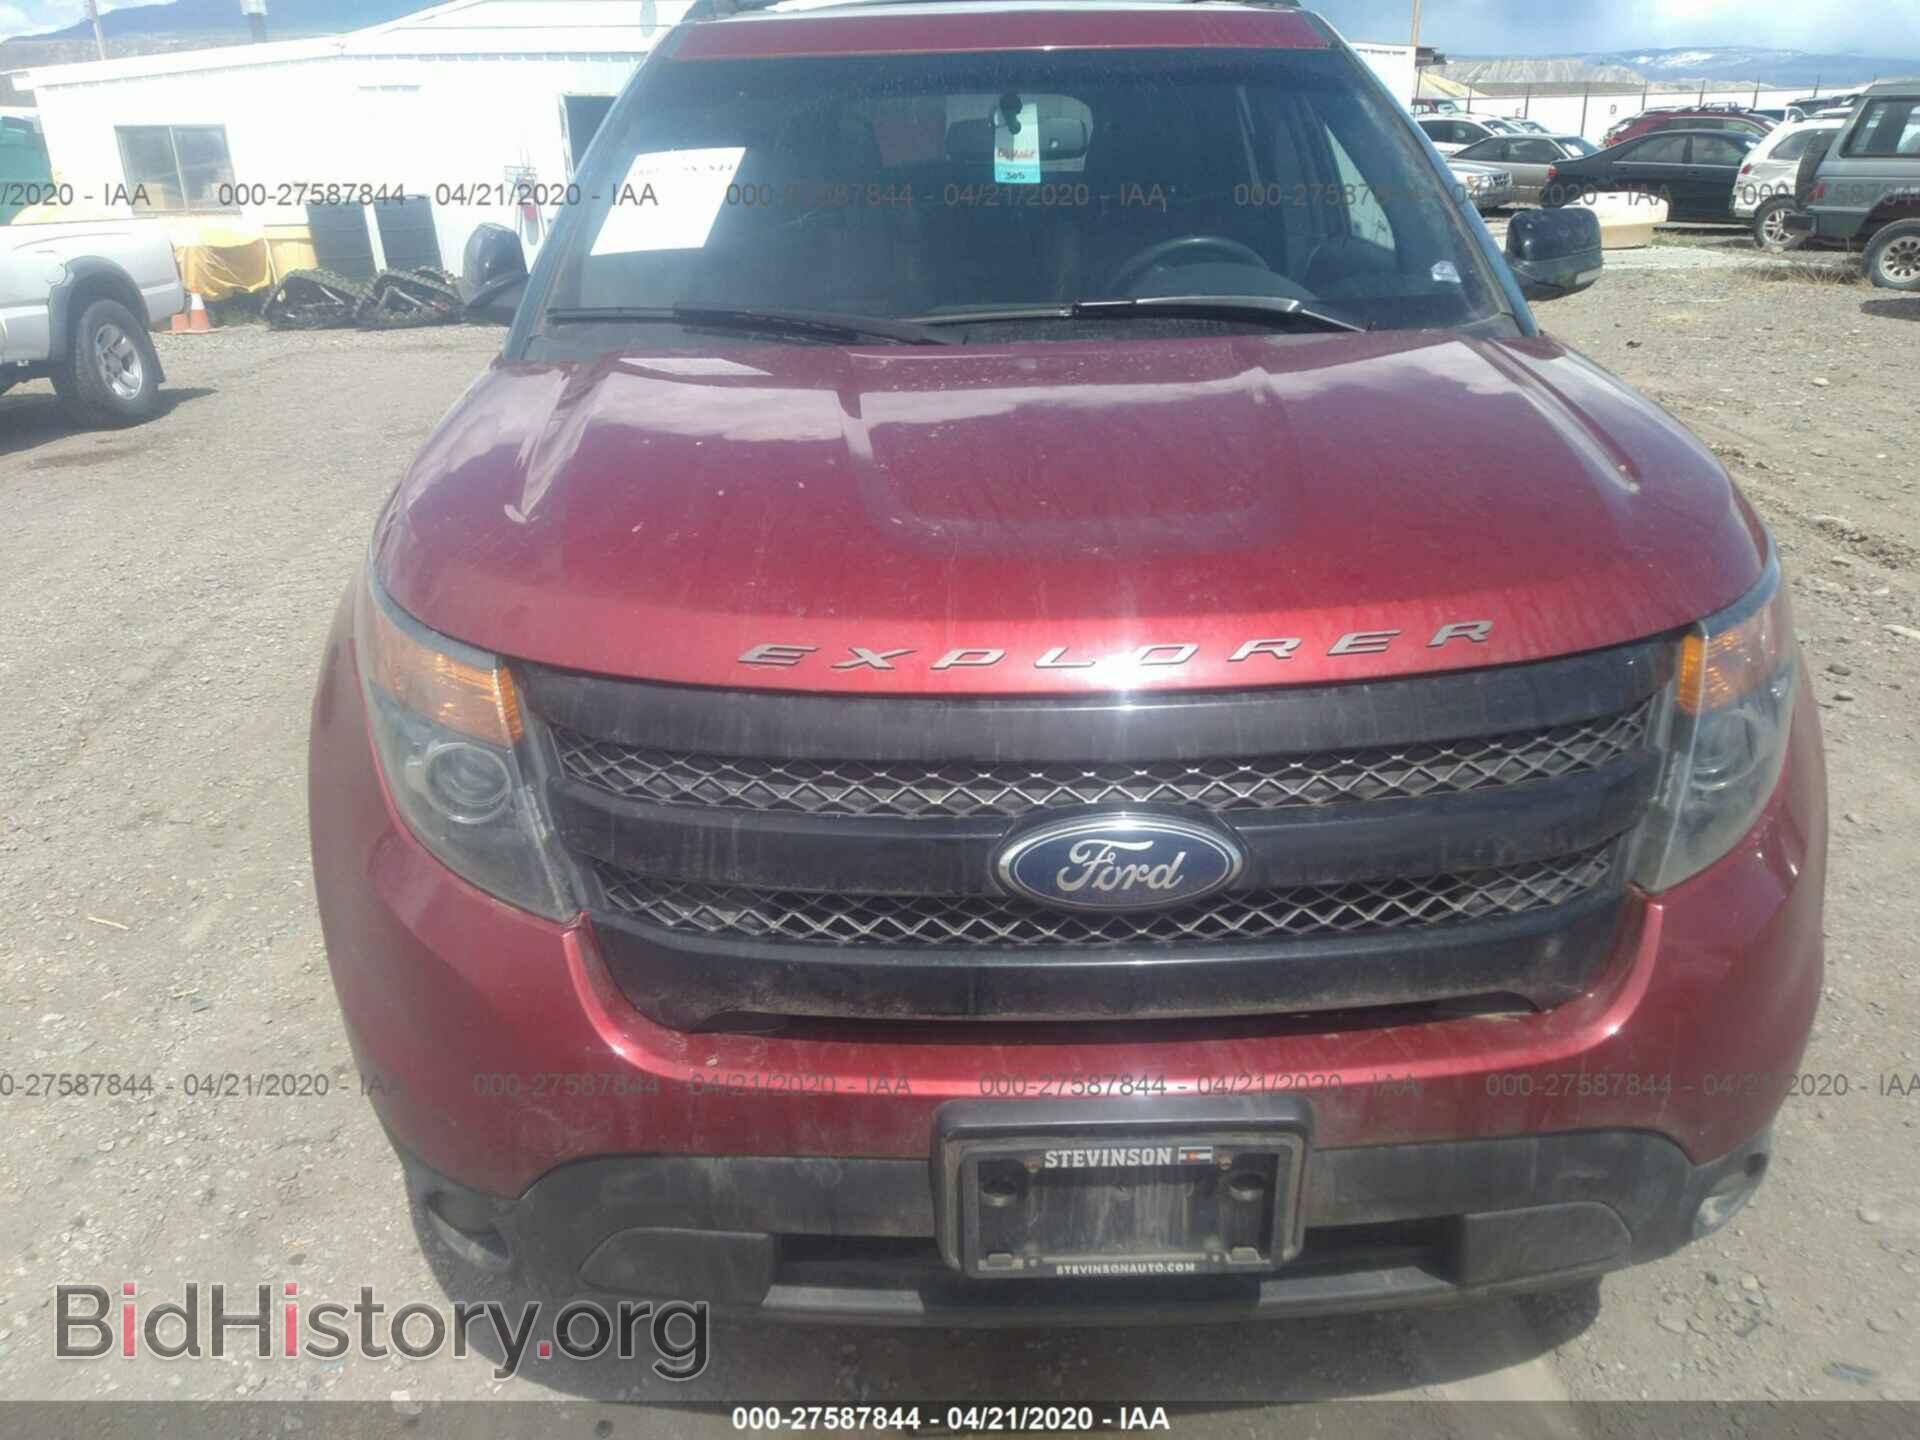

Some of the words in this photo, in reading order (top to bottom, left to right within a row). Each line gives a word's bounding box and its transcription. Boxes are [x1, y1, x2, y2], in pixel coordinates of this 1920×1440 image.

[737, 619, 1495, 672] EXPLORER
[1056, 838, 1186, 892] Ford
[1044, 1147, 1173, 1168] STEVINSON
